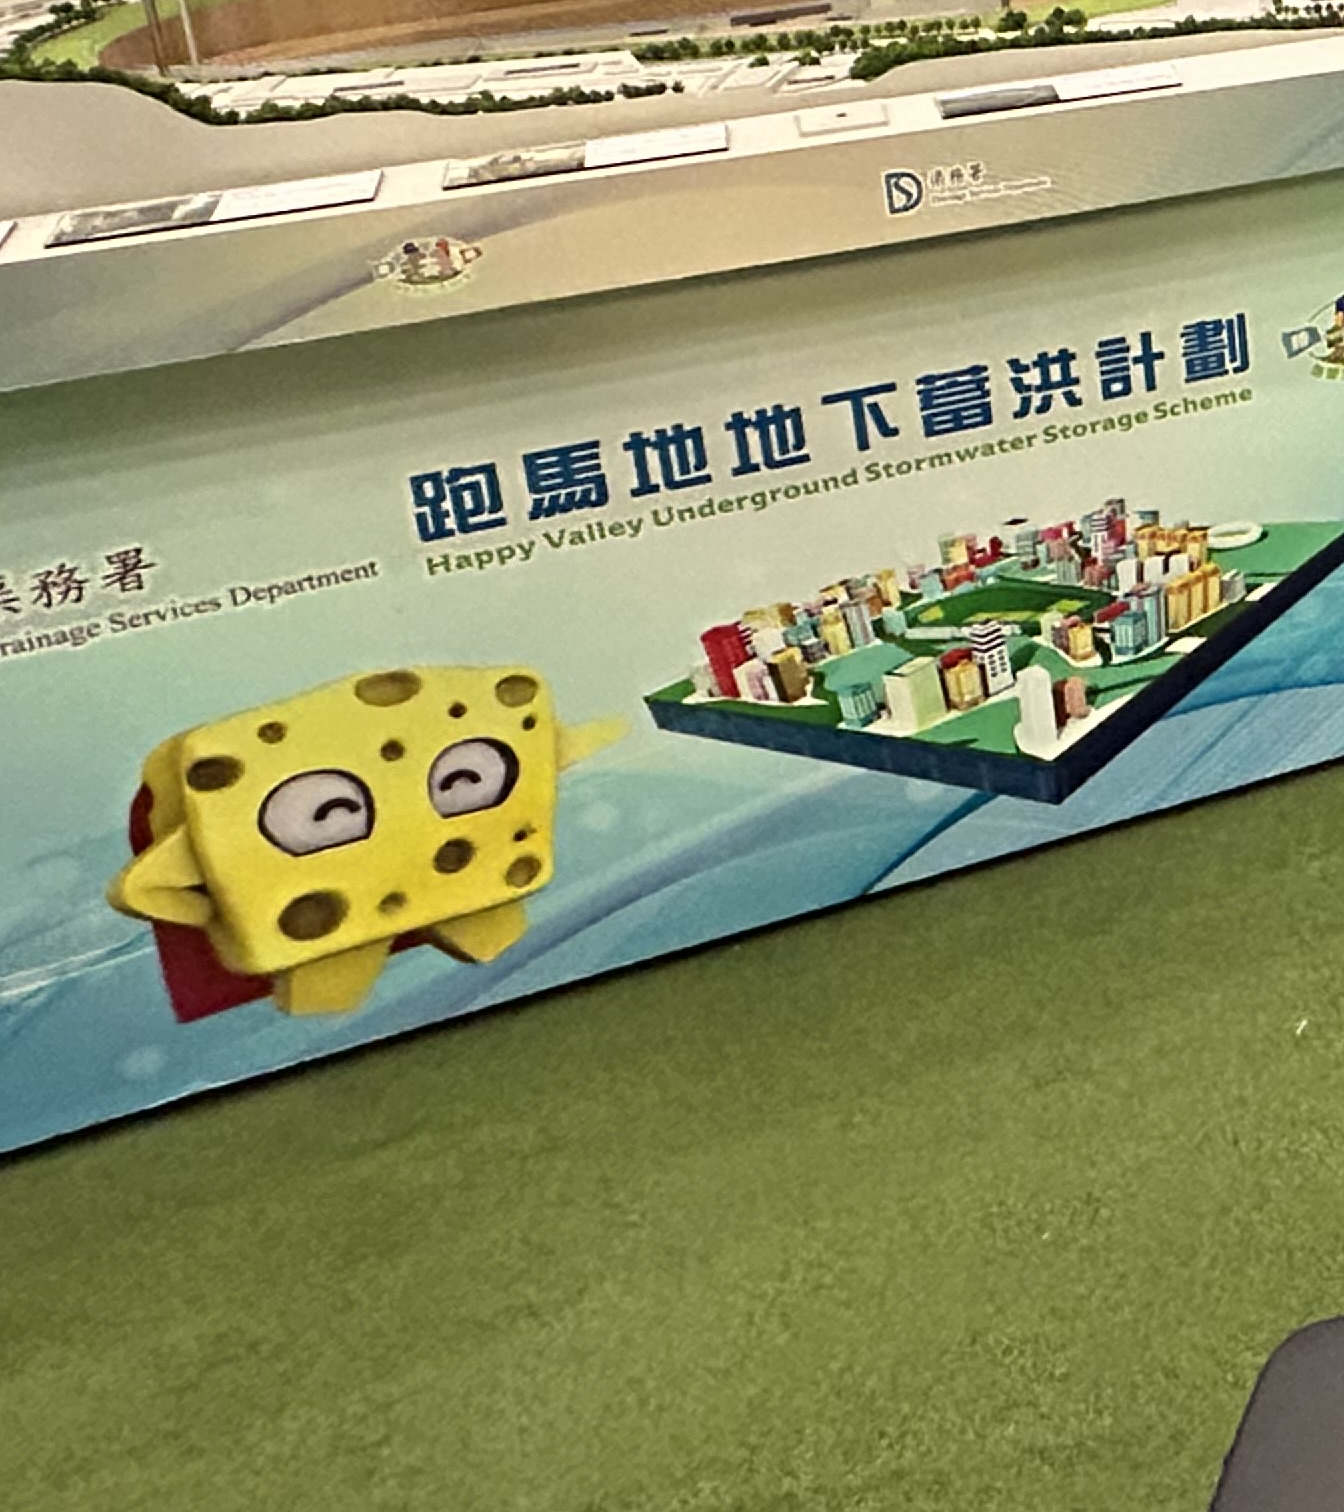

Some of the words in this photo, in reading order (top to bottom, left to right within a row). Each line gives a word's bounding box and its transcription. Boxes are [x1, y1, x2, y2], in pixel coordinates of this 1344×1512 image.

[409, 312, 1250, 543] 跑馬地地下蓄洪計劃
[427, 539, 536, 576] Happy
[543, 515, 645, 550] Valley
[652, 468, 860, 528] Underground
[865, 431, 1037, 482] Stormwater
[1042, 407, 1149, 445] Storage
[1153, 386, 1254, 421] Scheme
[0, 621, 101, 658] rainage
[108, 599, 222, 634] Services
[227, 561, 380, 609] Department
